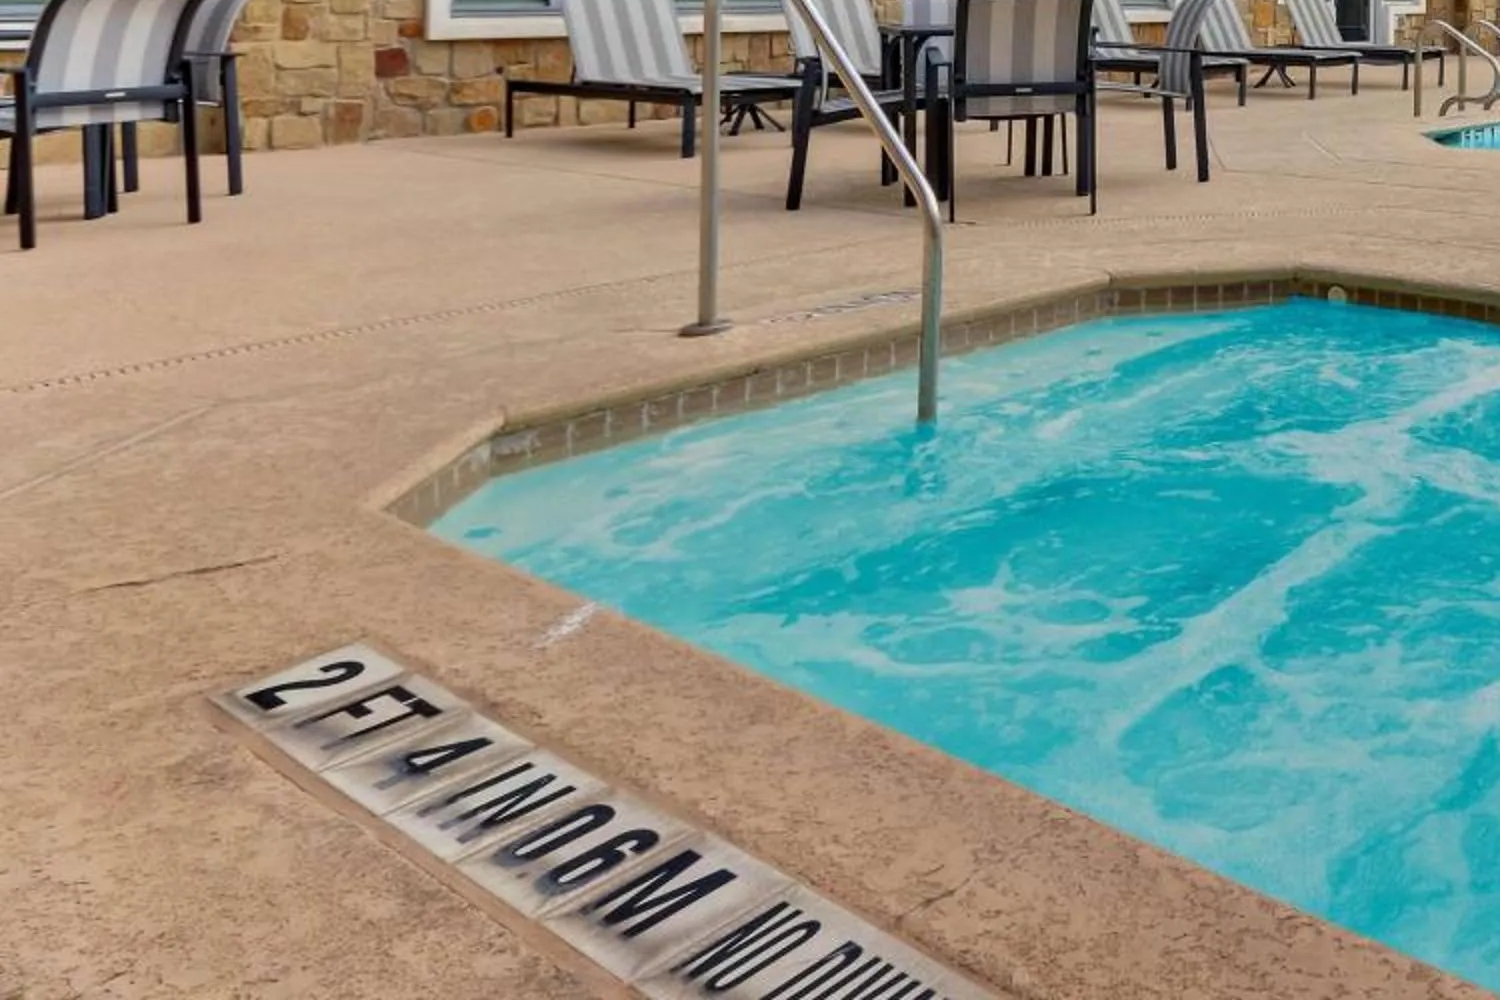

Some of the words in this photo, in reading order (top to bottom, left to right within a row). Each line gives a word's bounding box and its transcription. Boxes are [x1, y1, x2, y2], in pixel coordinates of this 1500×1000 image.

[244, 660, 366, 712] 2
[293, 685, 444, 750] FT
[372, 737, 494, 791] 4
[416, 761, 577, 844] IN
[578, 849, 738, 939] M
[668, 901, 822, 992] NO
